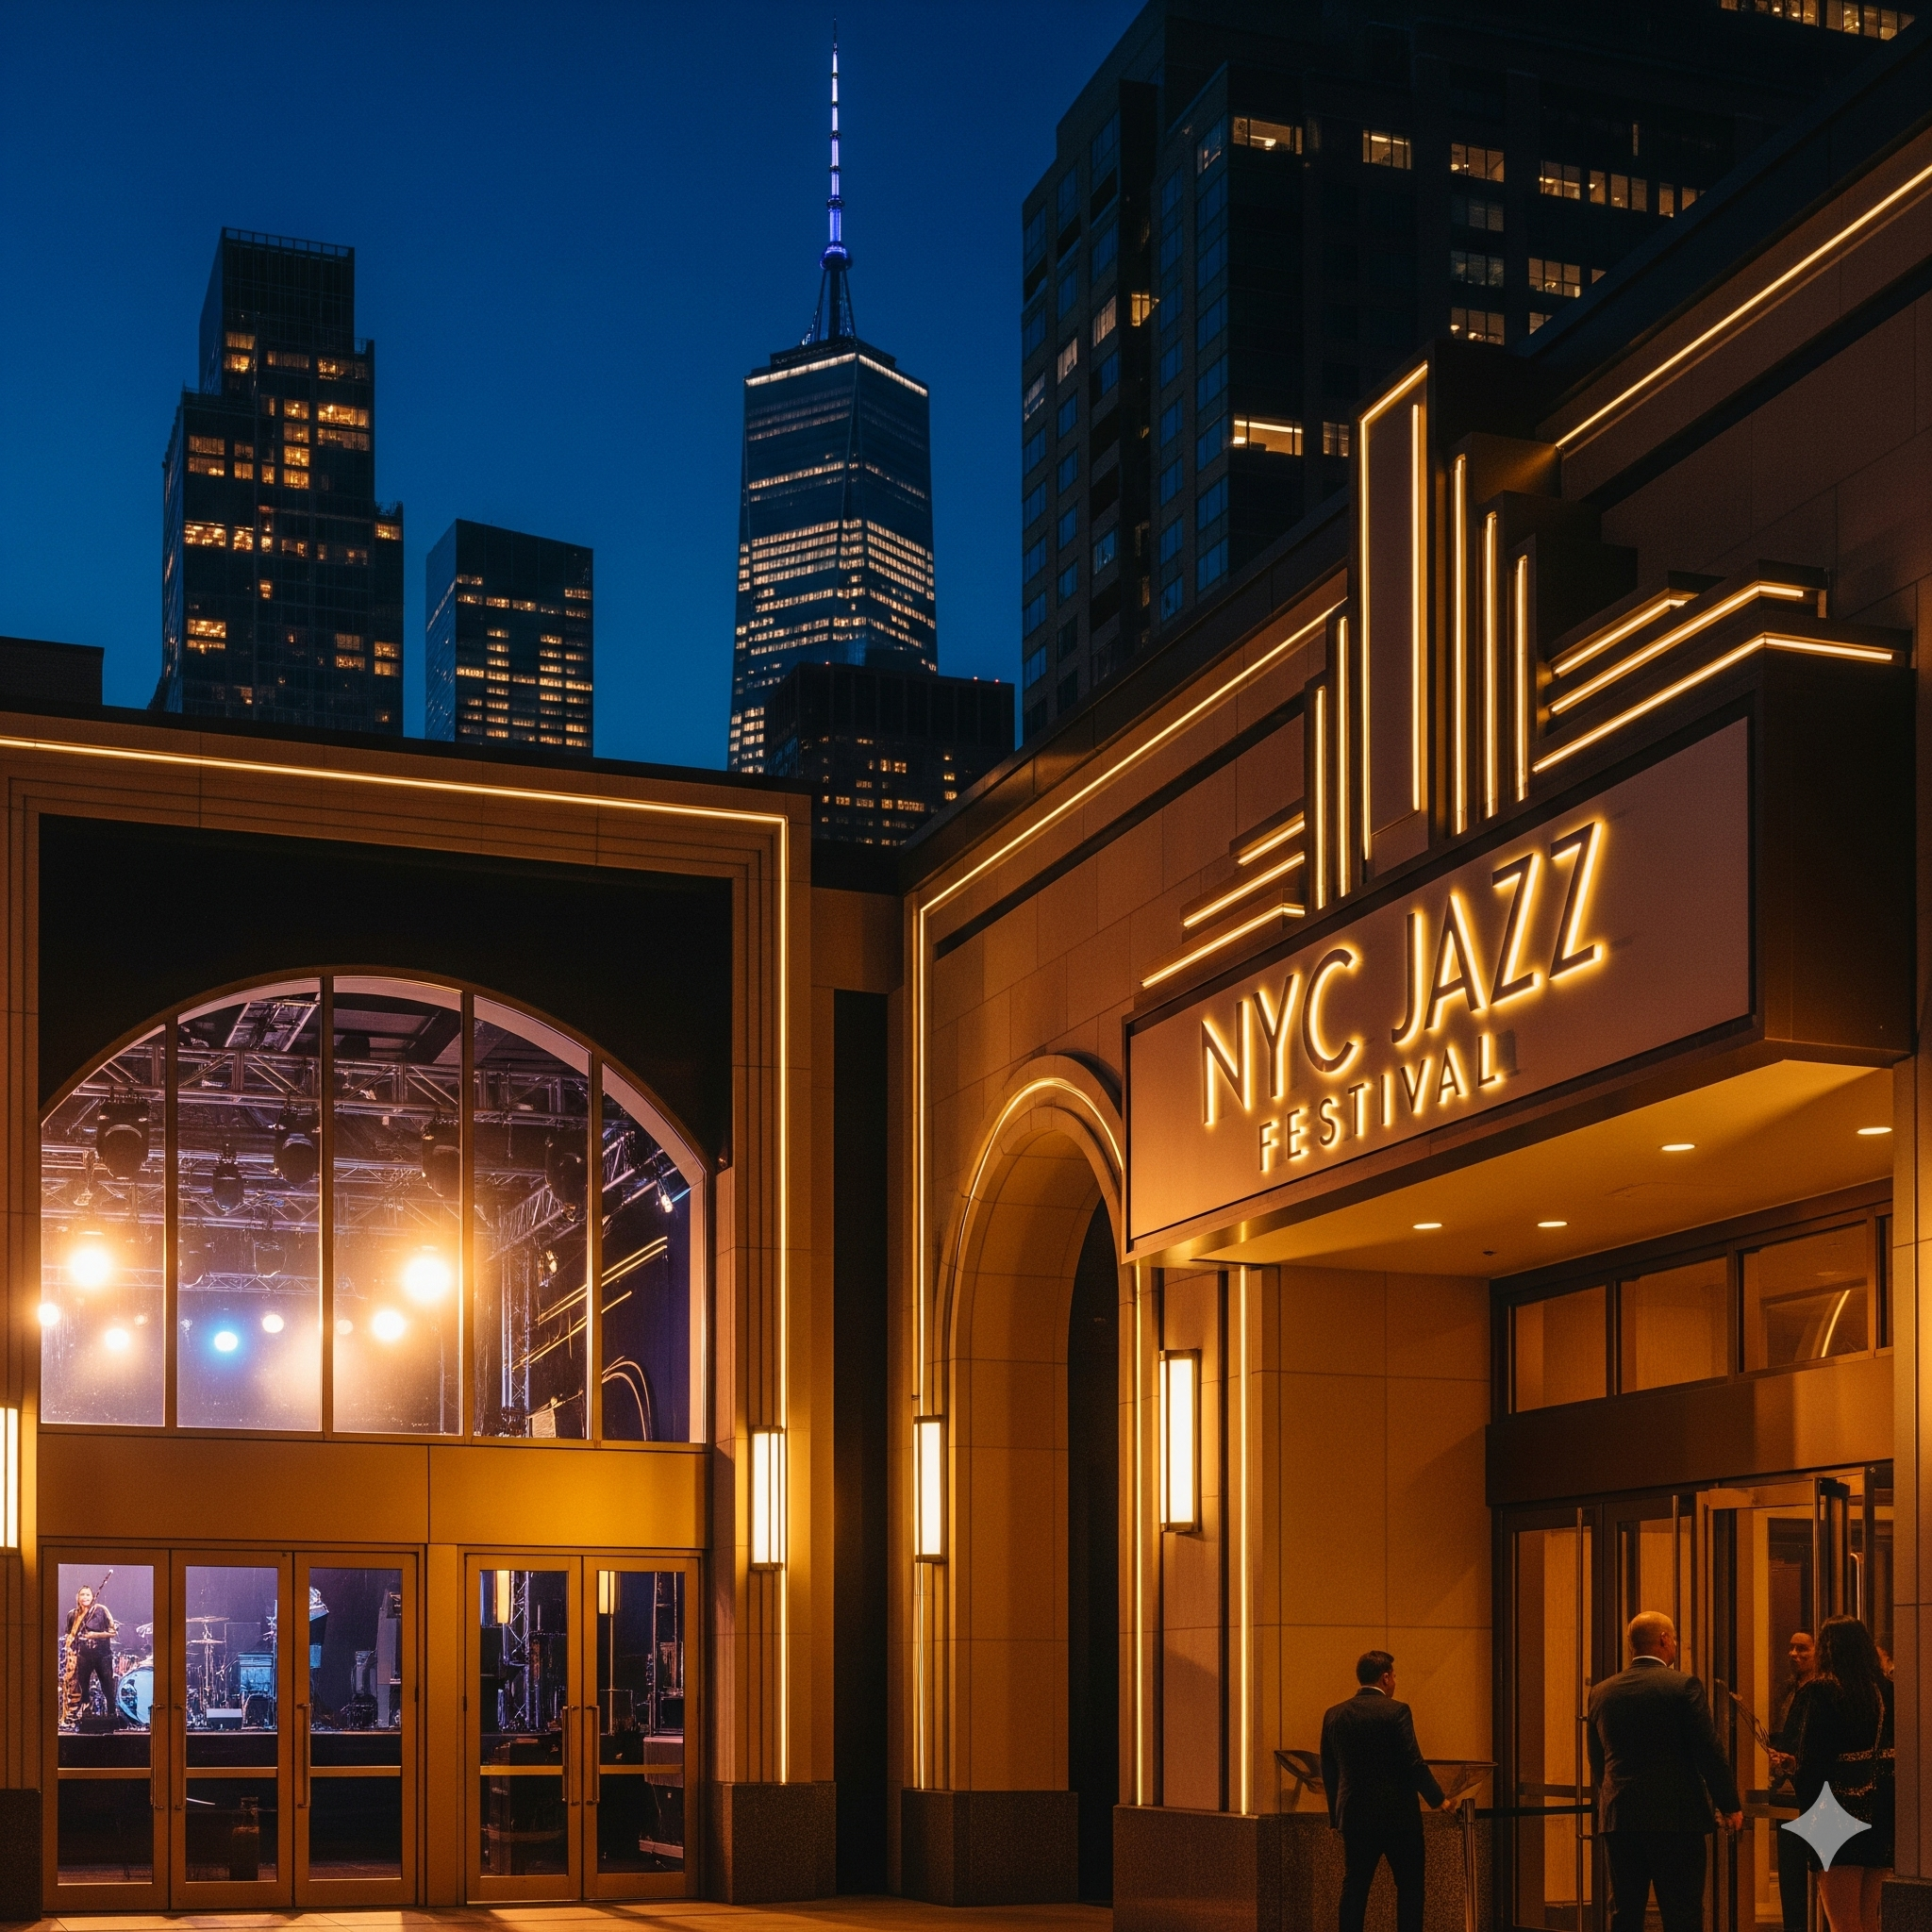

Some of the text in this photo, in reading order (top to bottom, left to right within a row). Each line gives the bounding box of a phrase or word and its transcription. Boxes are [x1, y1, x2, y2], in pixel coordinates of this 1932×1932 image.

[1202, 821, 1604, 1125] NYC JAZZ
[1258, 1033, 1506, 1172] FESTIVAL
